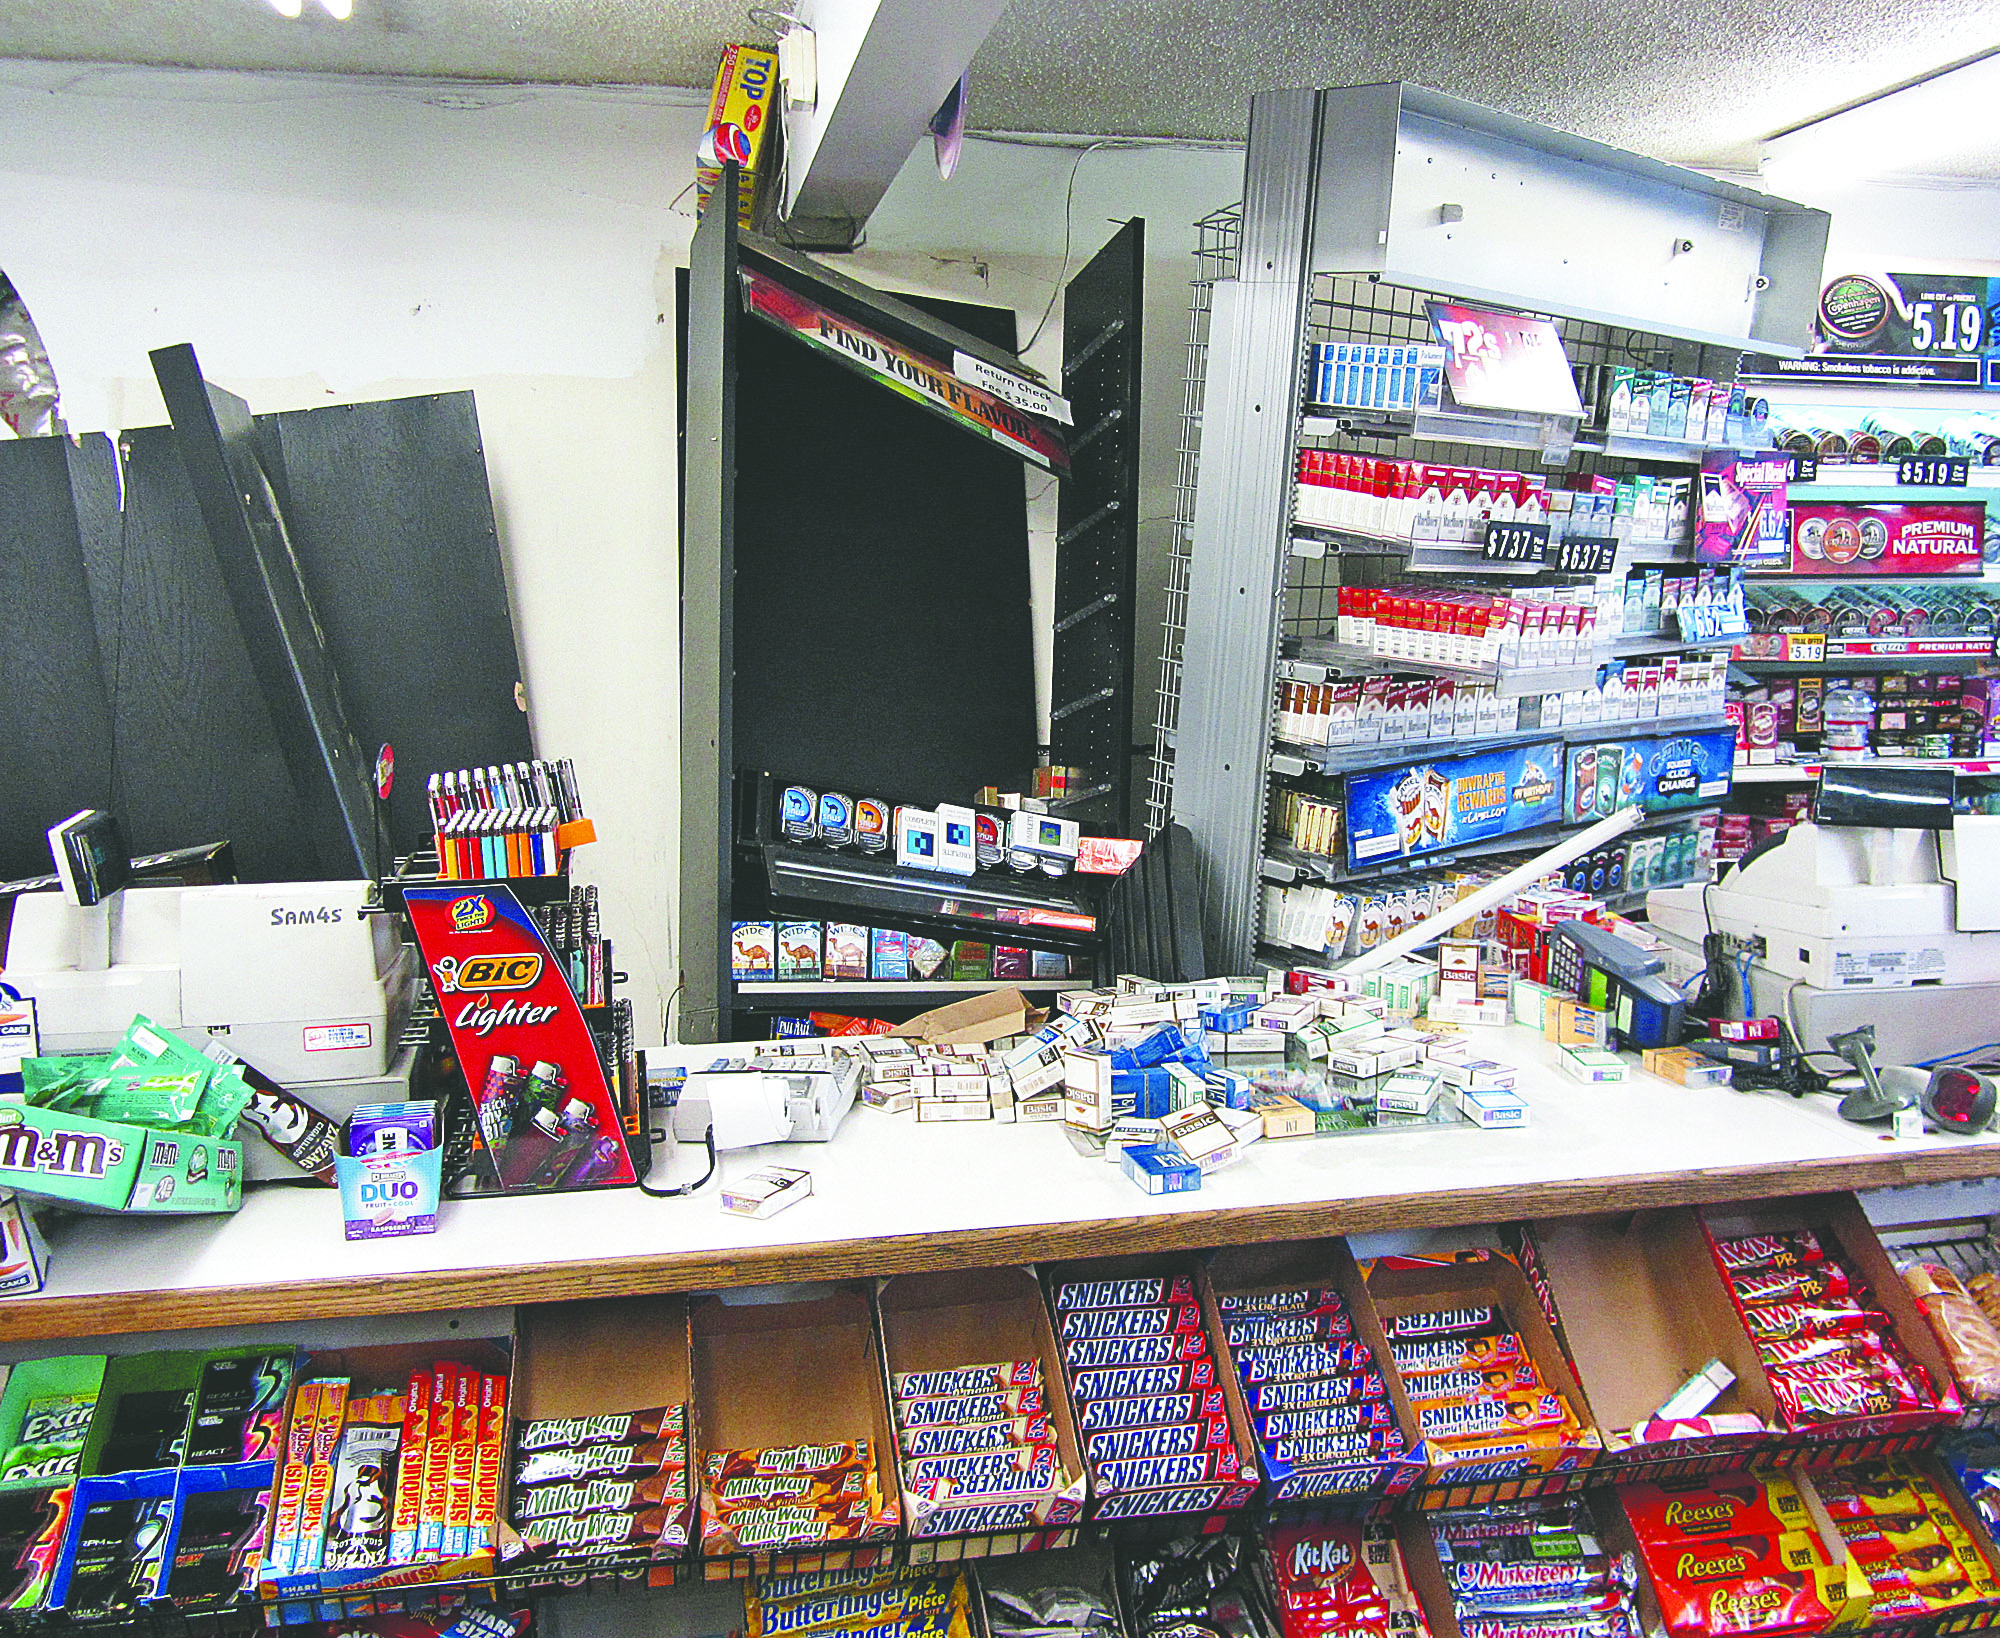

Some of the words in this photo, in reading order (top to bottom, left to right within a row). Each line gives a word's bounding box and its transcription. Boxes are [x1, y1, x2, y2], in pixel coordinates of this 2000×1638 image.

[727, 49, 737, 66] 250
[739, 55, 772, 100] TOP
[1827, 297, 1881, 315] Copenhagen
[1779, 361, 1820, 372] WARNING:
[1822, 362, 1861, 373] Smokeless
[1862, 363, 1891, 374] tobacco
[1893, 365, 1900, 374] is
[1901, 366, 1935, 376] addictive.
[818, 316, 877, 363] FIND
[884, 350, 944, 401] YOUR
[948, 378, 1038, 446] FLAVOR.
[975, 363, 1014, 388] Return
[1018, 378, 1052, 402] Check
[980, 380, 1002, 398] Fee
[1014, 394, 1048, 414] 35.00
[1735, 461, 1764, 487] Special
[1902, 463, 1948, 484] $5.19
[1759, 511, 1784, 539] 6.62
[1901, 520, 1974, 539] PREMIUM
[1892, 539, 1978, 554] NATURAL
[1694, 608, 1722, 637] 6.62
[1870, 643, 1908, 654] GRIZZLY
[1918, 643, 1963, 651] PREMIUM
[1649, 738, 1709, 777] CAMEL
[1456, 773, 1494, 793] UNWRAP
[1658, 777, 1696, 792] CHANGE
[1457, 787, 1506, 812] REWARDS
[786, 808, 805, 816] snus
[822, 814, 842, 823] snus
[904, 815, 937, 827] COMPLETE
[858, 820, 878, 829] snus
[976, 832, 994, 842] snus
[942, 848, 973, 860] COMPLETE
[456, 895, 485, 918] 2X
[456, 917, 485, 930] LIGHTS
[1443, 970, 1476, 981] Basic
[455, 999, 559, 1036] Lighter
[1, 1025, 28, 1034] CAKE
[480, 1097, 507, 1114] FLICK
[1066, 1087, 1095, 1104] Basic
[482, 1111, 502, 1124] MY
[1026, 1103, 1056, 1114] Basic
[1493, 1110, 1520, 1120] Basic
[1174, 1115, 1216, 1139] Basic
[293, 1121, 324, 1158] CIGARILLOS
[361, 1181, 418, 1202] DUO
[370, 1224, 411, 1233] RASPBERRY
[1717, 1236, 1785, 1269] TWIX
[1774, 1252, 1797, 1269] PB
[1059, 1279, 1161, 1309] SNICKERS
[1731, 1272, 1812, 1299] TWIX
[1799, 1281, 1823, 1299] PB
[1064, 1308, 1170, 1337] SNICKERS
[1399, 1306, 1489, 1330] SNICKERS
[1069, 1336, 1174, 1366] SNICKERS
[1016, 1361, 1031, 1376] 2
[1428, 1355, 1461, 1368] butter
[1775, 1360, 1863, 1379] TWIX
[905, 1367, 999, 1396] SNICKERS
[1076, 1366, 1183, 1399] SNICKERS
[1273, 1373, 1288, 1382] 3X
[1288, 1367, 1336, 1380] CHOCOLATE
[1521, 1367, 1532, 1378] 4
[247, 1355, 283, 1412] 5
[434, 1373, 444, 1403] Original
[458, 1377, 467, 1407] Original
[484, 1378, 493, 1408] Original
[953, 1384, 998, 1395] Almond
[408, 1381, 419, 1413] Original
[1023, 1390, 1038, 1405] 2
[1260, 1378, 1351, 1410] SNICKERS
[1281, 1402, 1296, 1411] 3X
[1297, 1396, 1347, 1409] CHOCOLATE
[1545, 1395, 1557, 1407] 4
[1803, 1379, 1882, 1411] TWIX
[911, 1394, 1006, 1424] SNICKERS
[1085, 1394, 1193, 1428] SNICKERS
[1421, 1401, 1505, 1427] SNICKERS
[1867, 1396, 1891, 1413] PB
[958, 1412, 1005, 1424] Almond
[1030, 1417, 1046, 1430] 2
[1267, 1406, 1361, 1438] SNICKERS
[1467, 1420, 1499, 1434] butter
[245, 1410, 272, 1461] 5
[915, 1422, 1012, 1454] SNICKERS
[1089, 1424, 1198, 1460] SNICKERS
[1289, 1431, 1304, 1440] 3X
[1305, 1425, 1357, 1437] CHOCOLATE
[191, 1448, 226, 1457] REACT
[965, 1443, 1012, 1453] Almond
[1317, 1449, 1368, 1460] CHOCOLATE
[425, 1439, 449, 1517] starburst
[1100, 1454, 1207, 1488] SNICKERS
[397, 1446, 424, 1525] starburst
[475, 1443, 498, 1521] starburst
[952, 1468, 1050, 1495] SNICKERS
[1279, 1467, 1379, 1497] SNICKERS
[1317, 1485, 1369, 1496] CHOCOLATE
[1099, 1487, 1222, 1518] SNICKERS
[922, 1501, 1036, 1535] SNICKERS
[976, 1520, 1030, 1531] Almond
[1369, 1554, 1390, 1564] SIZE
[1789, 1549, 1811, 1558] KING
[1792, 1556, 1813, 1567] SIZE
[900, 1563, 936, 1580] Piece
[1463, 1563, 1476, 1583] 3
[1478, 1563, 1577, 1588] Musketeers
[281, 1585, 318, 1593] SHARE
[761, 1585, 909, 1636] Butterfinger
[909, 1593, 946, 1613] Piece
[461, 1606, 517, 1638] SHARE
